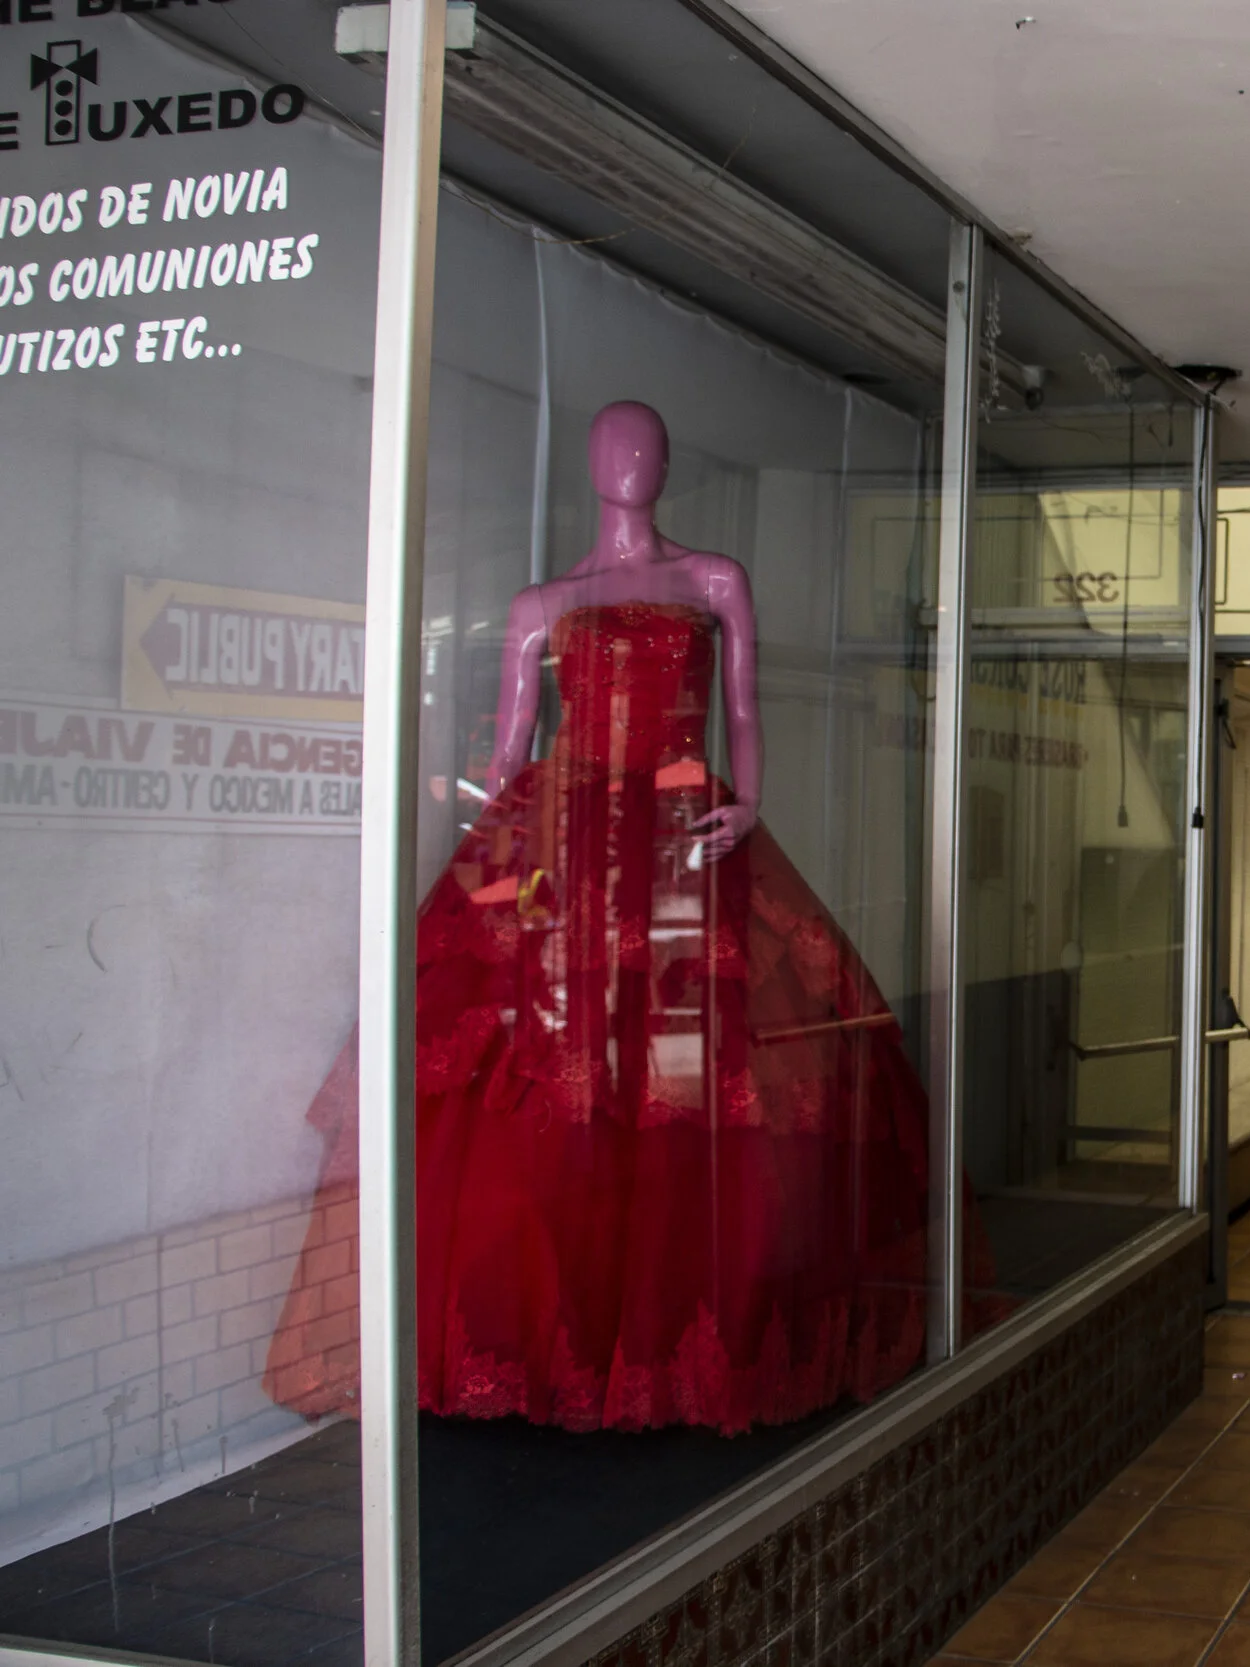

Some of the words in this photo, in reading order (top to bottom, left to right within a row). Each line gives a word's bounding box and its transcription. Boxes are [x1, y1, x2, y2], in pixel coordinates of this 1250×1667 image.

[99, 181, 153, 229] DE
[163, 166, 288, 222] NOVIA
[49, 233, 320, 302] COMUNIONES
[136, 316, 243, 363] ETC...
